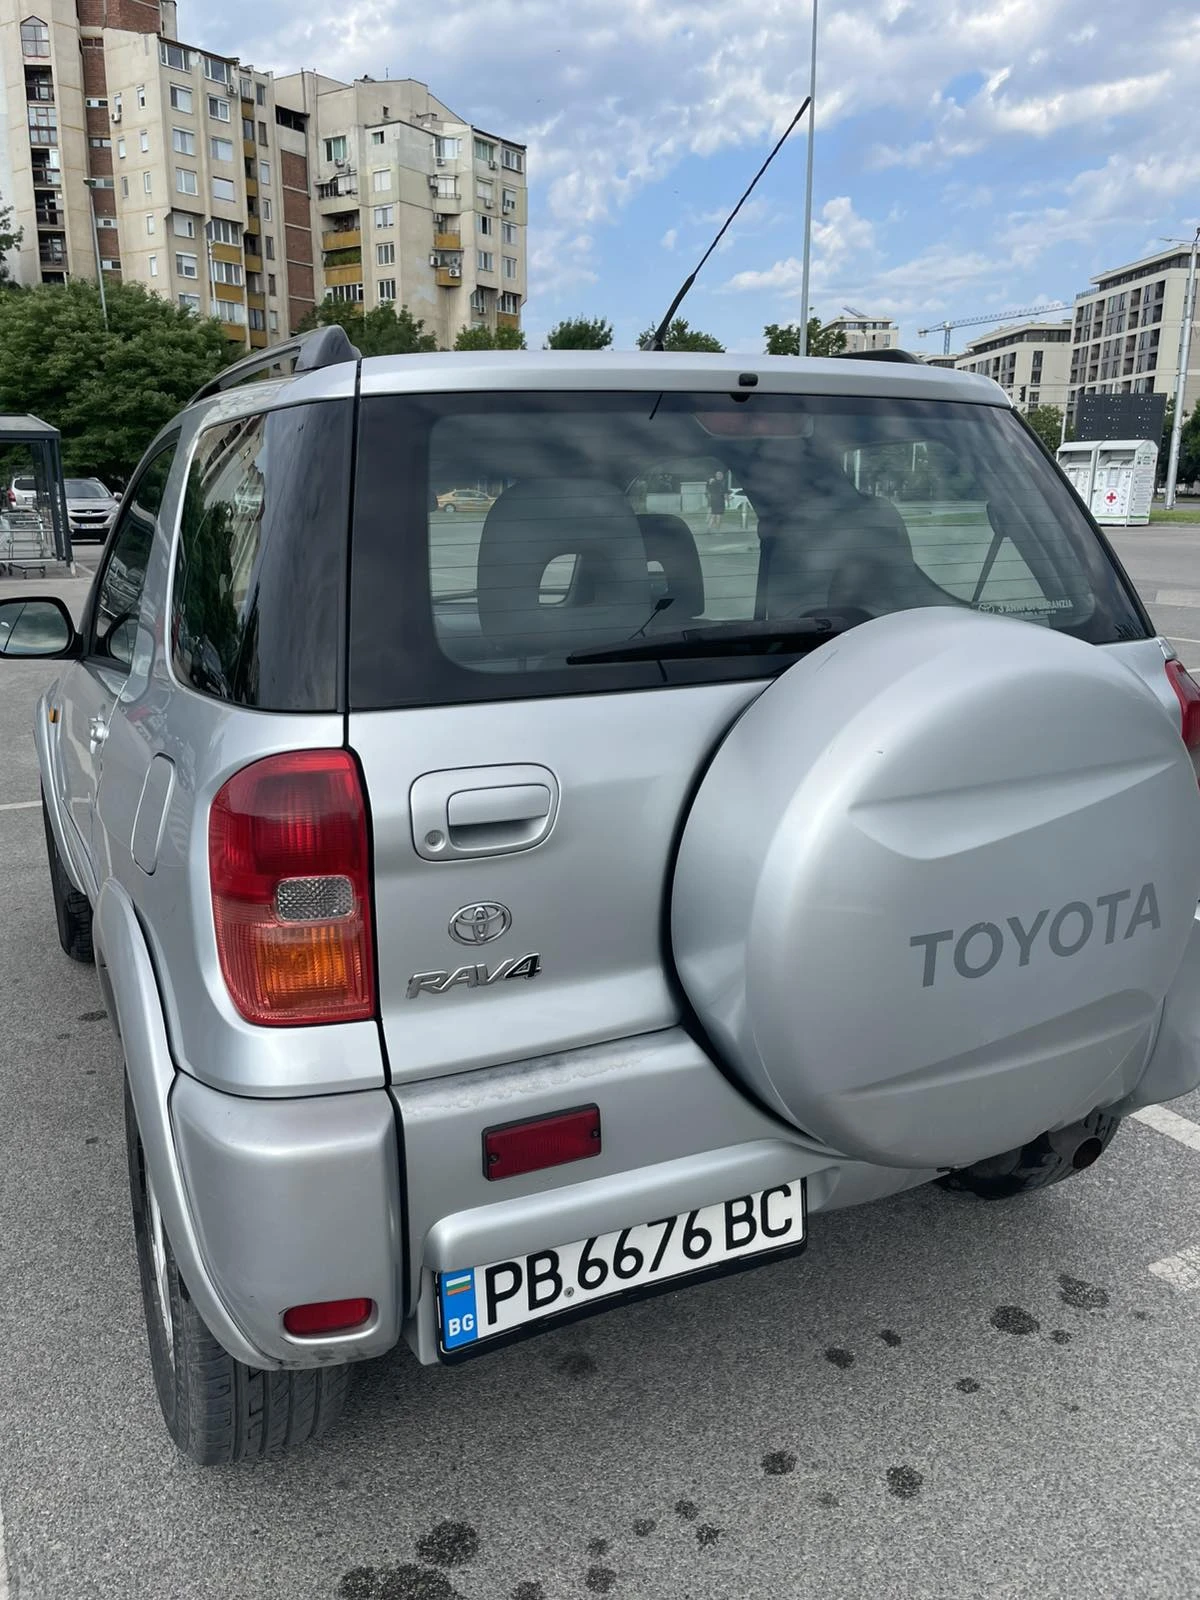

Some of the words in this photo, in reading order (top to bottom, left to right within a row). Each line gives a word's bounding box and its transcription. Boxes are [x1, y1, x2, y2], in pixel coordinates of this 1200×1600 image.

[910, 882, 1161, 987] TOYOTA
[406, 952, 542, 999] RAV4
[485, 1249, 563, 1325] PB
[577, 1208, 712, 1290] 6676
[724, 1183, 792, 1250] BC
[449, 1313, 474, 1337] BG
